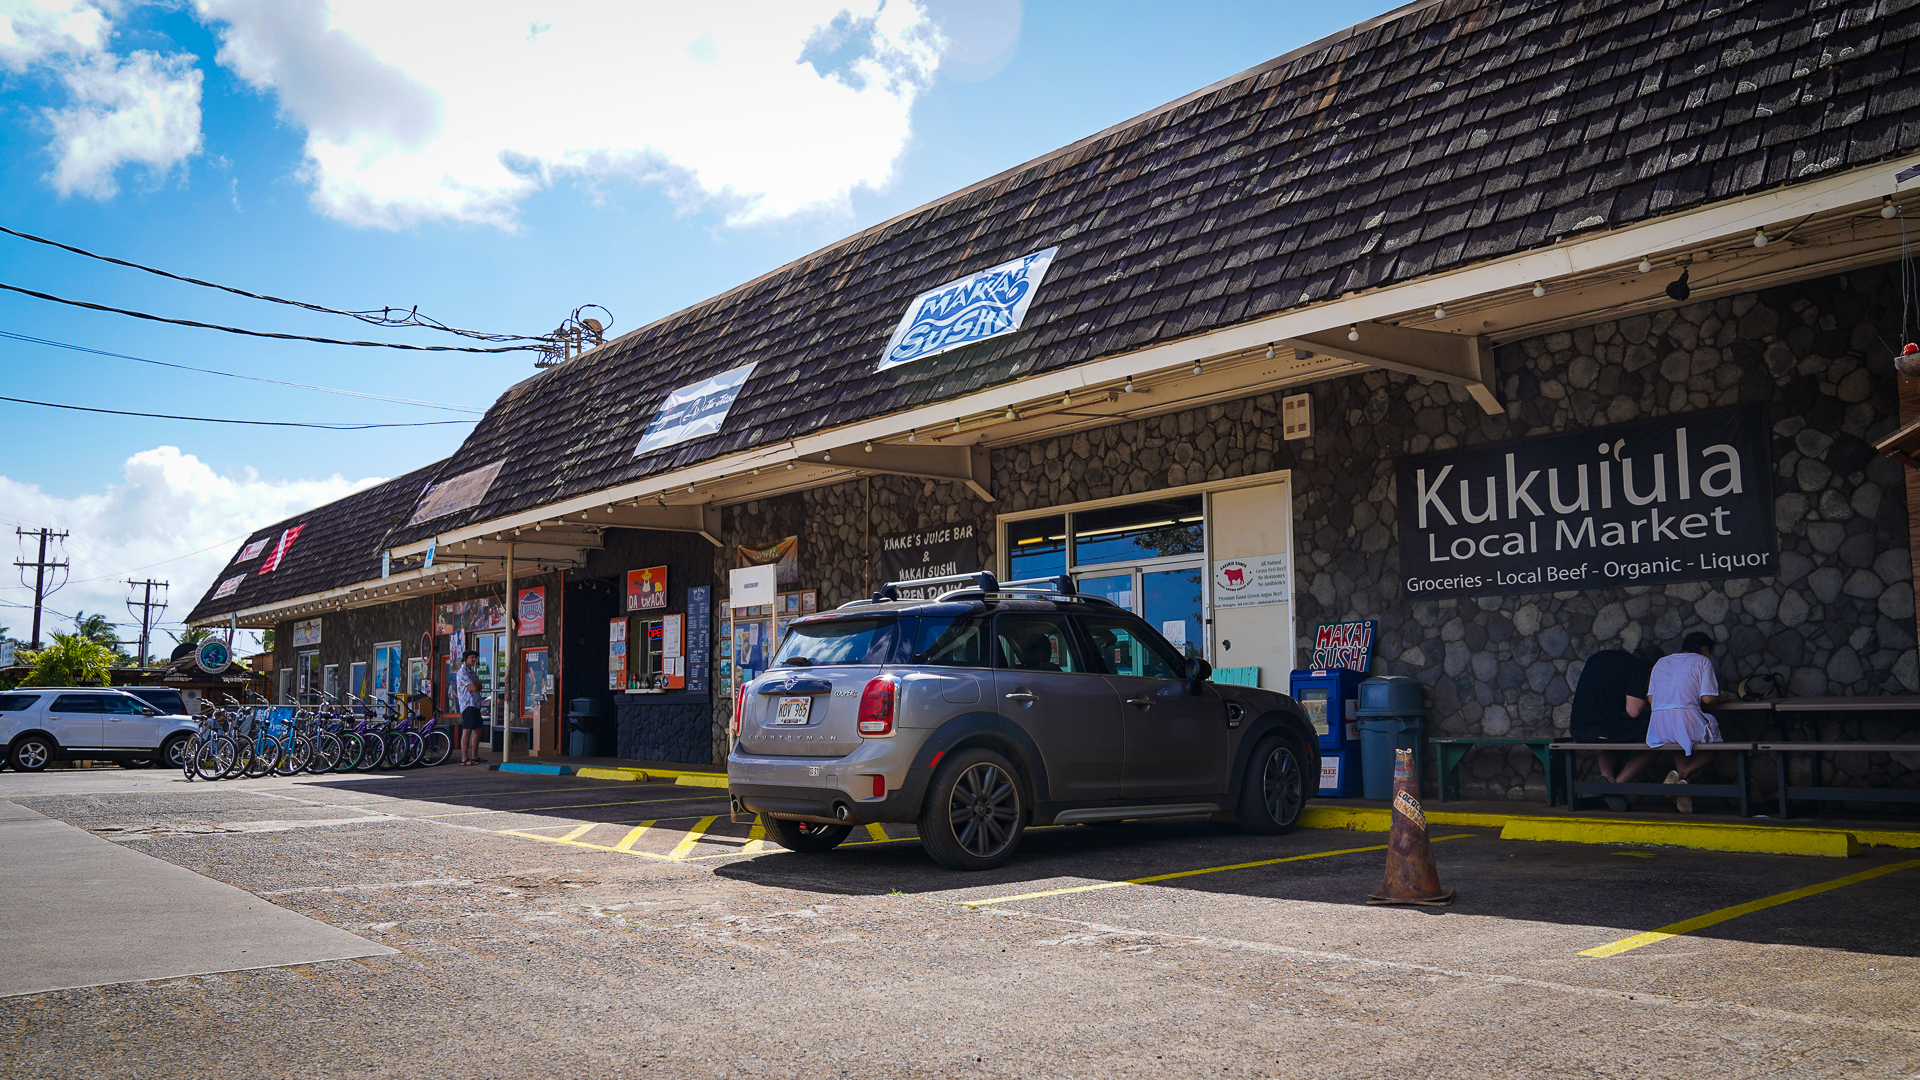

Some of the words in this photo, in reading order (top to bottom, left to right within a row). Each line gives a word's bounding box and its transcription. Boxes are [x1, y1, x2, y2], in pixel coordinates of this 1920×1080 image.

[914, 267, 1030, 322] MAKAI
[889, 309, 1011, 361] SUSHI
[923, 529, 951, 545] JUICE
[953, 525, 973, 540] BAR
[1429, 520, 1538, 562] Local
[1555, 506, 1732, 551] Market
[922, 551, 930, 562] &
[899, 566, 926, 582] MAKAI
[927, 561, 957, 578] SUSHI
[1406, 573, 1482, 592] Groceries
[1496, 566, 1542, 586] Local
[1547, 563, 1589, 582] Beef
[1603, 556, 1682, 581] Organic
[1699, 551, 1770, 571] Liquor
[628, 596, 638, 609] DA
[641, 591, 665, 608] CRACK
[525, 652, 540, 663] PADDLE
